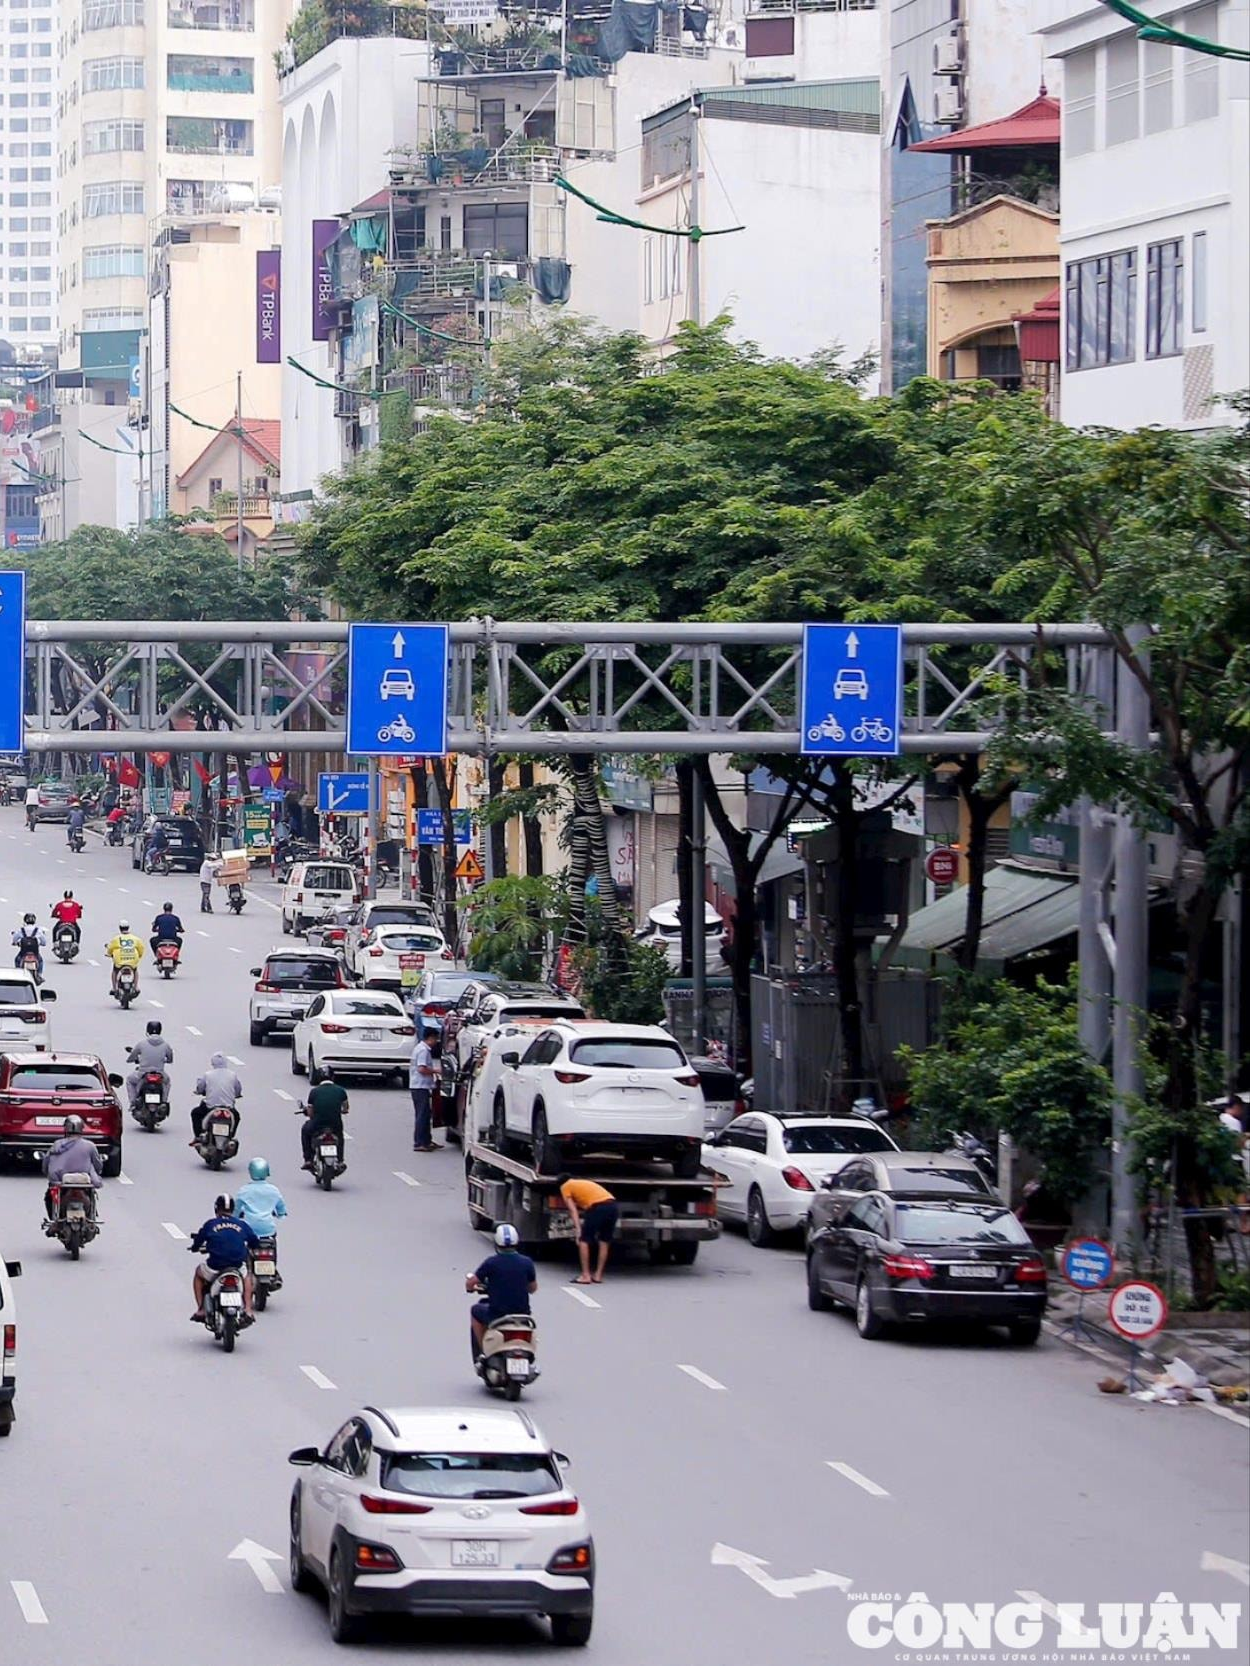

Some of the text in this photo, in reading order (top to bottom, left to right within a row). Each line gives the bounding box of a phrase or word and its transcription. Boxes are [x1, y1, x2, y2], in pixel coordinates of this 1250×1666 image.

[262, 291, 275, 341] TPBank
[119, 936, 134, 947] be
[212, 1222, 243, 1233] FRANCE
